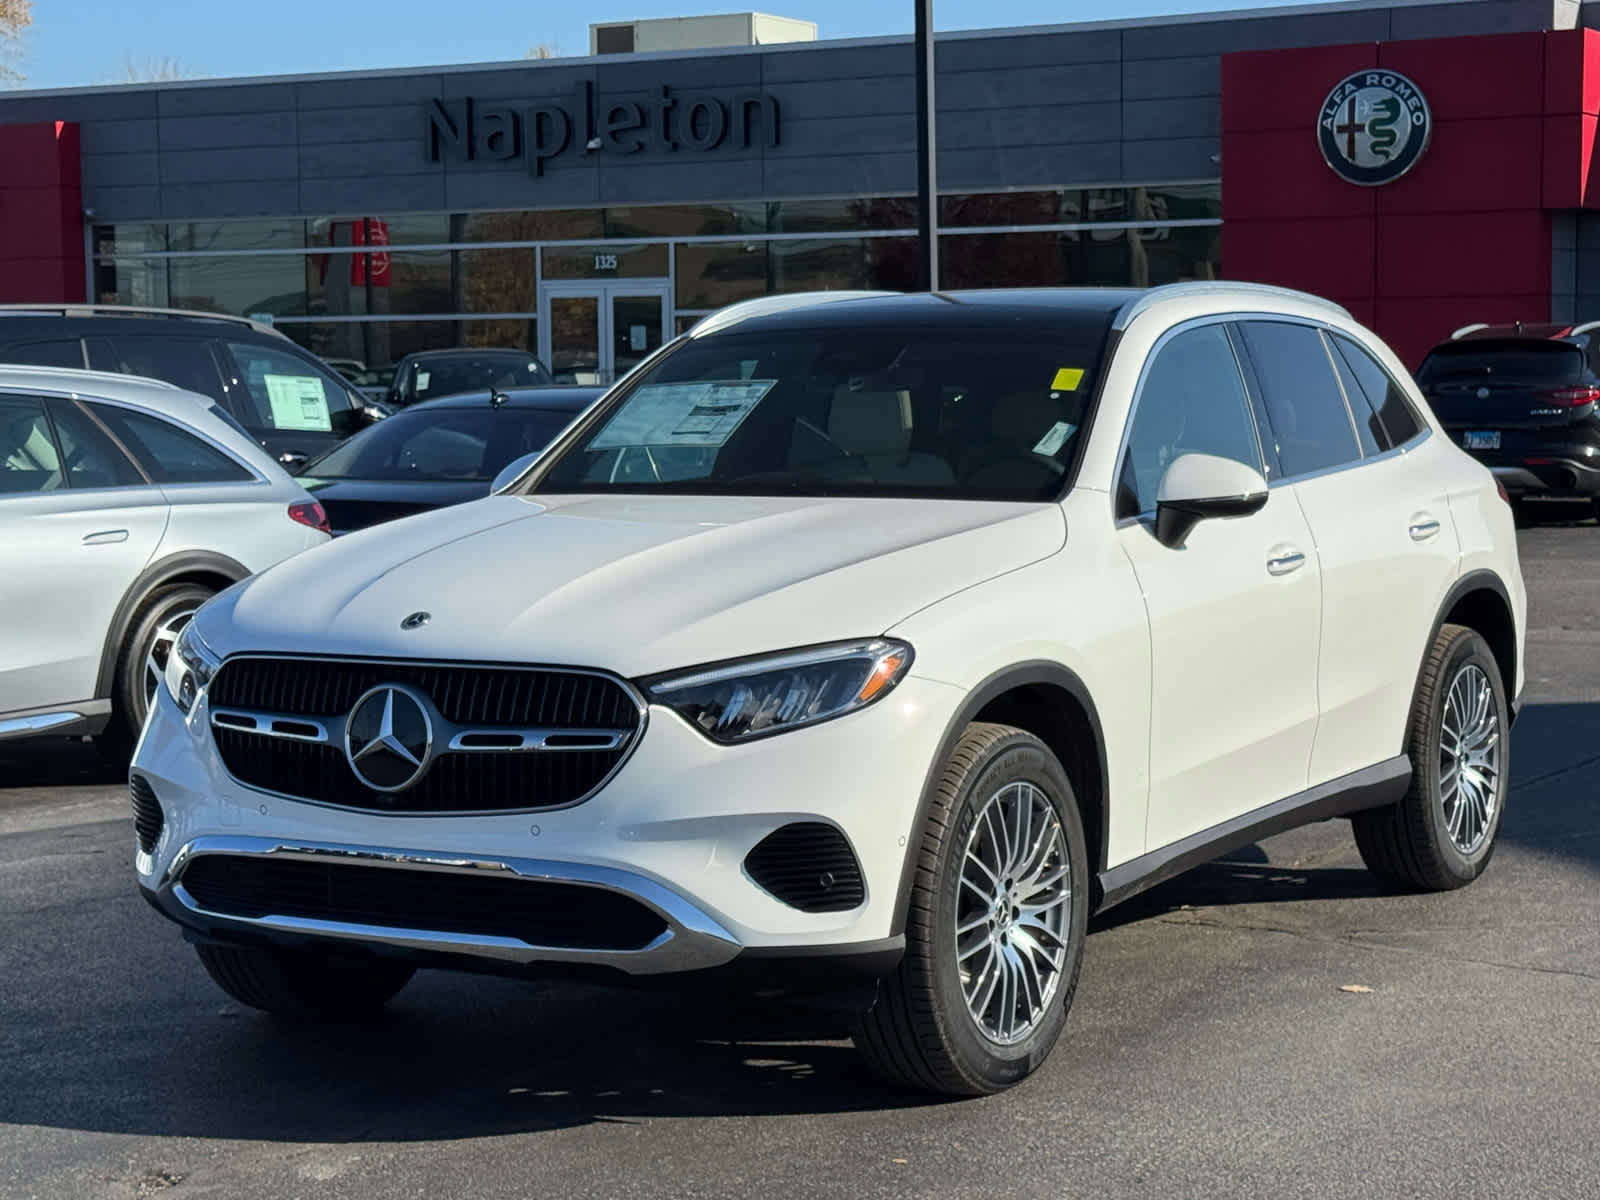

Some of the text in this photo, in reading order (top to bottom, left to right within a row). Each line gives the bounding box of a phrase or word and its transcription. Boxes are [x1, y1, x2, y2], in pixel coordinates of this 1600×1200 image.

[424, 80, 783, 177] Napleton
[1322, 74, 1425, 130] ALFA ROMEO
[594, 255, 617, 269] 1325
